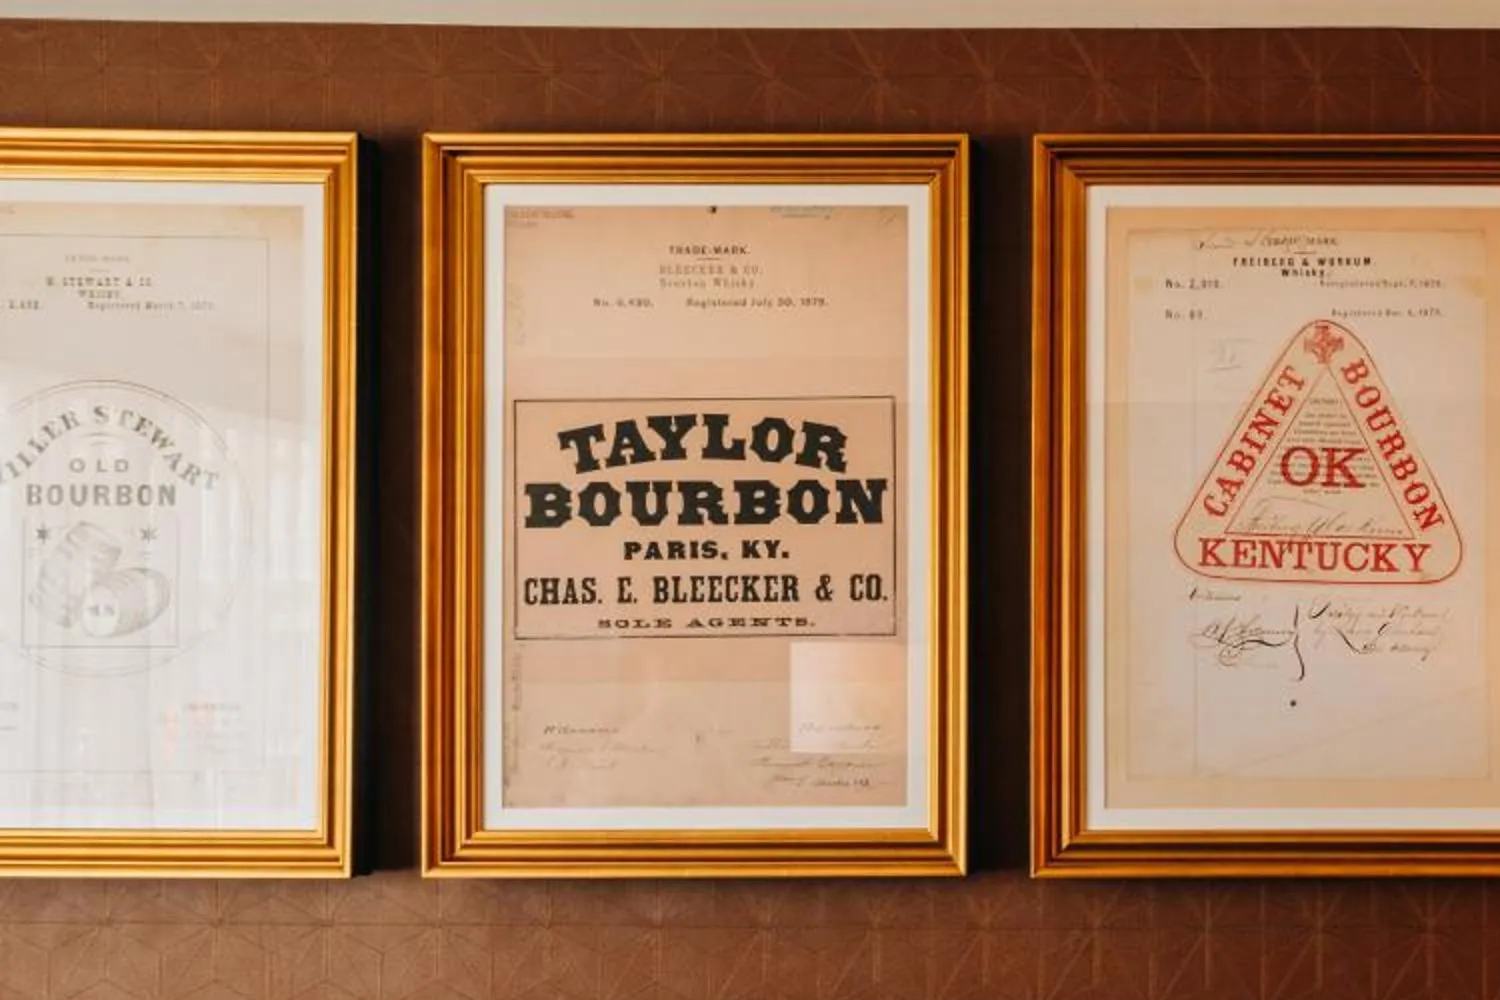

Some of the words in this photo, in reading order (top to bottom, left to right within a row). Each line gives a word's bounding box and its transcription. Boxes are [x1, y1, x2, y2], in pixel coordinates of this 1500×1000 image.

[1301, 257, 1310, 267] &
[0, 410, 81, 485] ILLER
[93, 405, 219, 490] STEWART
[557, 413, 848, 474] TAYLOR
[1203, 365, 1305, 519] CABINET
[1341, 358, 1445, 532] BOURBON
[69, 458, 129, 473] OLD
[1281, 446, 1367, 488] OK
[26, 483, 177, 507] BOURBON
[524, 478, 888, 529] BOURBON
[623, 540, 729, 561] PARIS,
[741, 539, 790, 560] KY.
[1198, 537, 1432, 573] KENTUCKY
[524, 576, 603, 606] CHAS.
[616, 576, 638, 605] E.
[653, 574, 800, 605] BLEECKER
[815, 574, 834, 602] &
[849, 573, 889, 602] CO.
[597, 618, 673, 630] SOLE
[685, 616, 816, 629] AGENTS.
